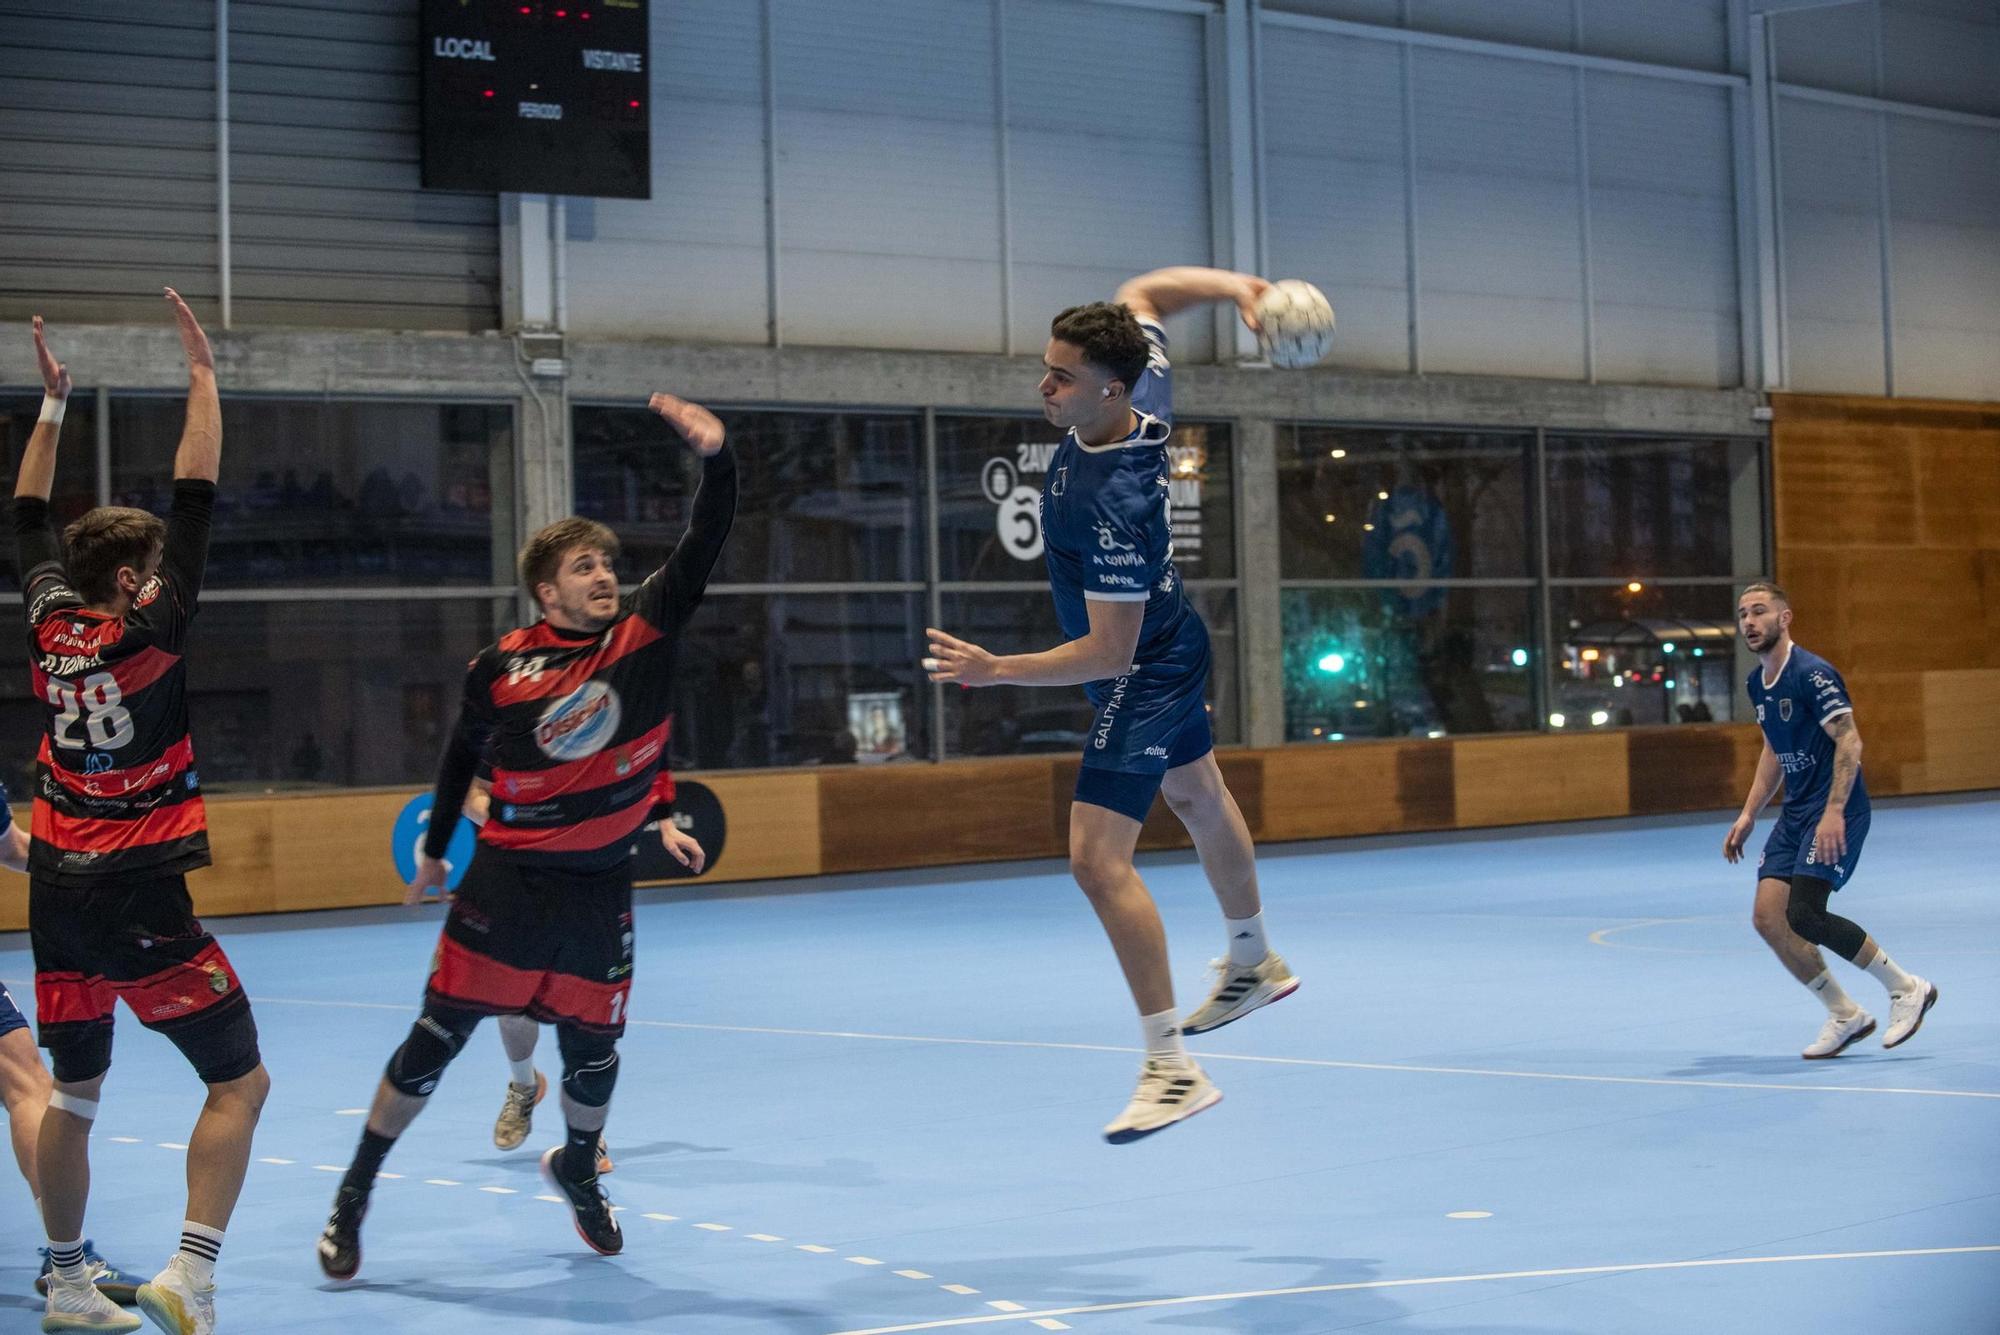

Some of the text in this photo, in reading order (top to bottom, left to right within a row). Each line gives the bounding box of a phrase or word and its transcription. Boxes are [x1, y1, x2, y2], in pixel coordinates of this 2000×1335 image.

[434, 37, 496, 61] LOCAL
[46, 671, 135, 750] 28
[1094, 677, 1129, 750] GALITRANS
[608, 991, 628, 1024] 1
